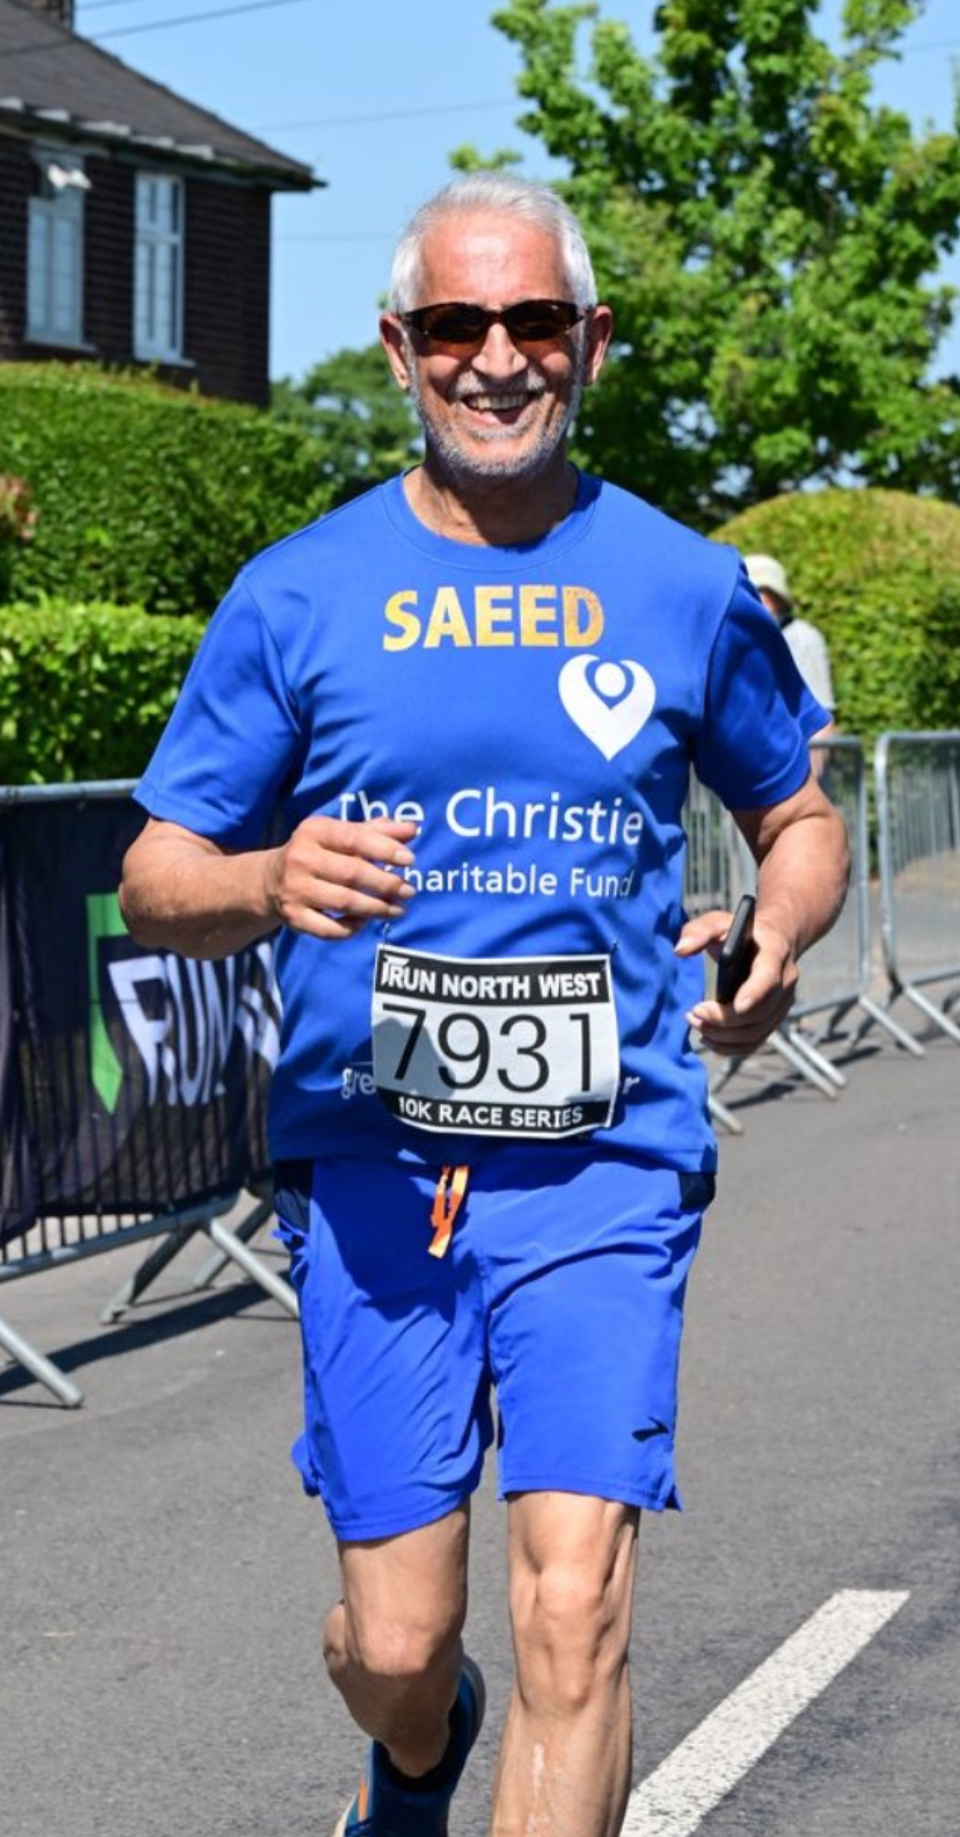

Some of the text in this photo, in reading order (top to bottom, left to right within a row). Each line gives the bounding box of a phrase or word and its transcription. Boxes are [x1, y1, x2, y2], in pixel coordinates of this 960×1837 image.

[382, 584, 605, 652] SAEED
[445, 786, 644, 845] Christie
[384, 862, 634, 899] haritable Fund
[441, 972, 531, 999] NORTH
[538, 972, 602, 998] WEST
[382, 1002, 592, 1094] 7931
[399, 1095, 583, 1129] 10K RACE SERIES
